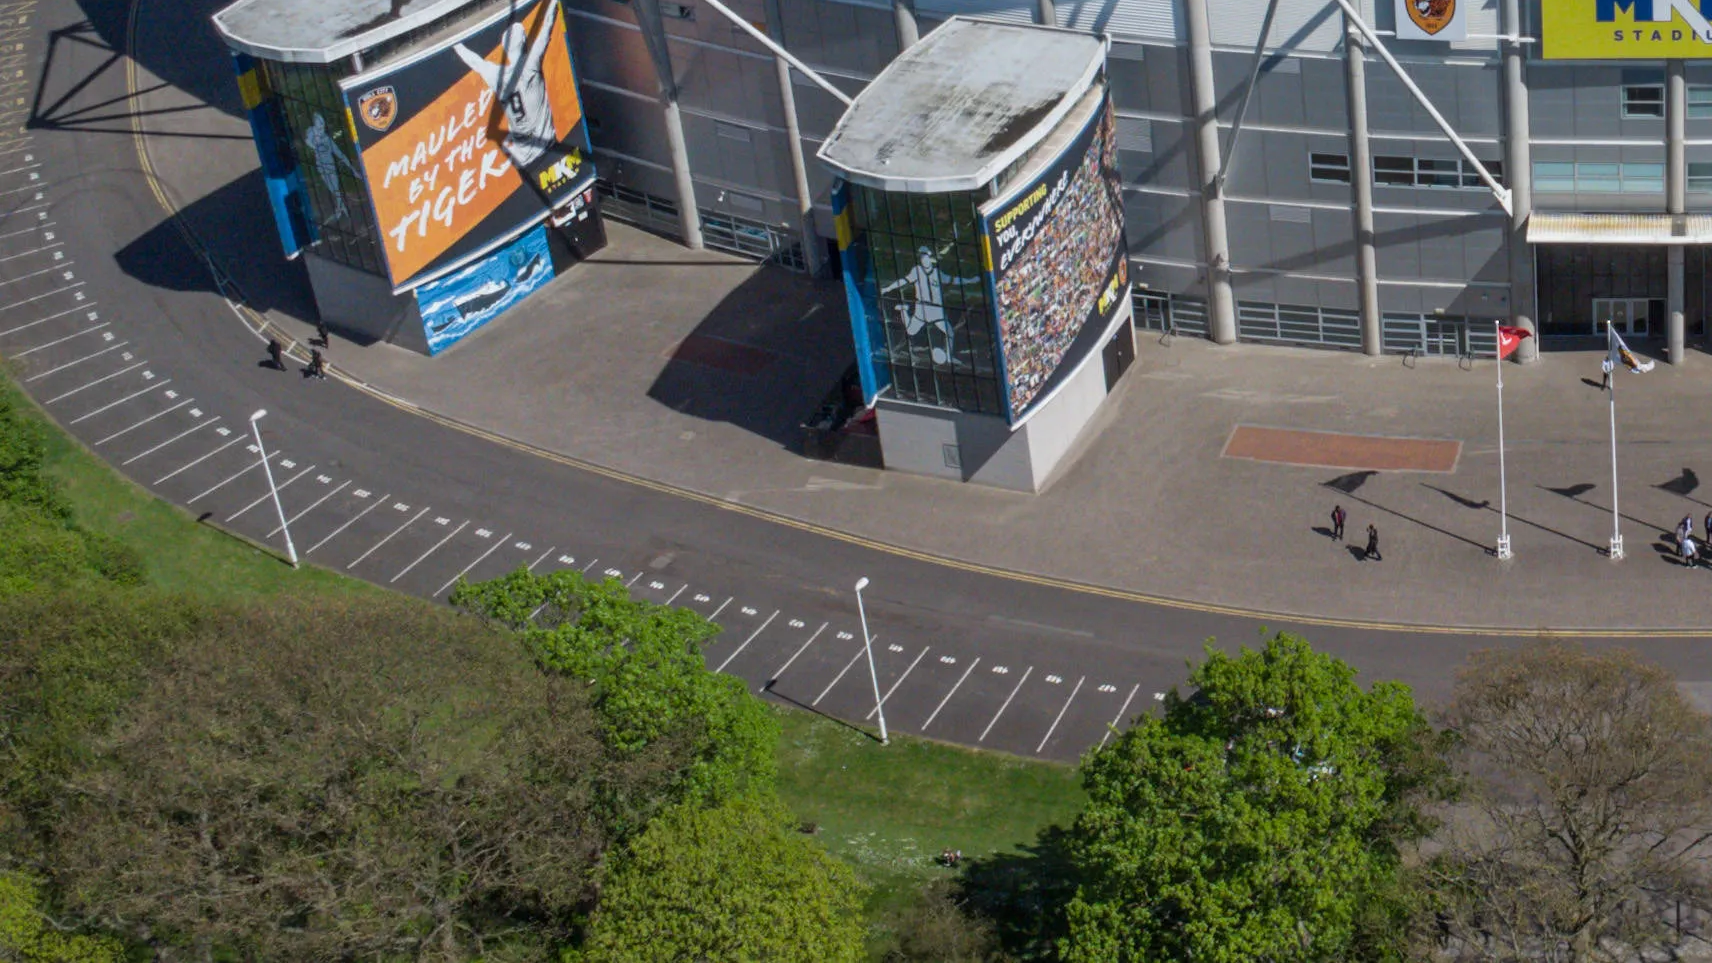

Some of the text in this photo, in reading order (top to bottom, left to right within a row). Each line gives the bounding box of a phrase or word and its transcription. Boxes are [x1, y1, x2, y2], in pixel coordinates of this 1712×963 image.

[383, 87, 493, 188] MAULED
[409, 126, 488, 204] BY THE
[389, 149, 512, 252] TIGER
[994, 182, 1047, 233] SUPPORTING
